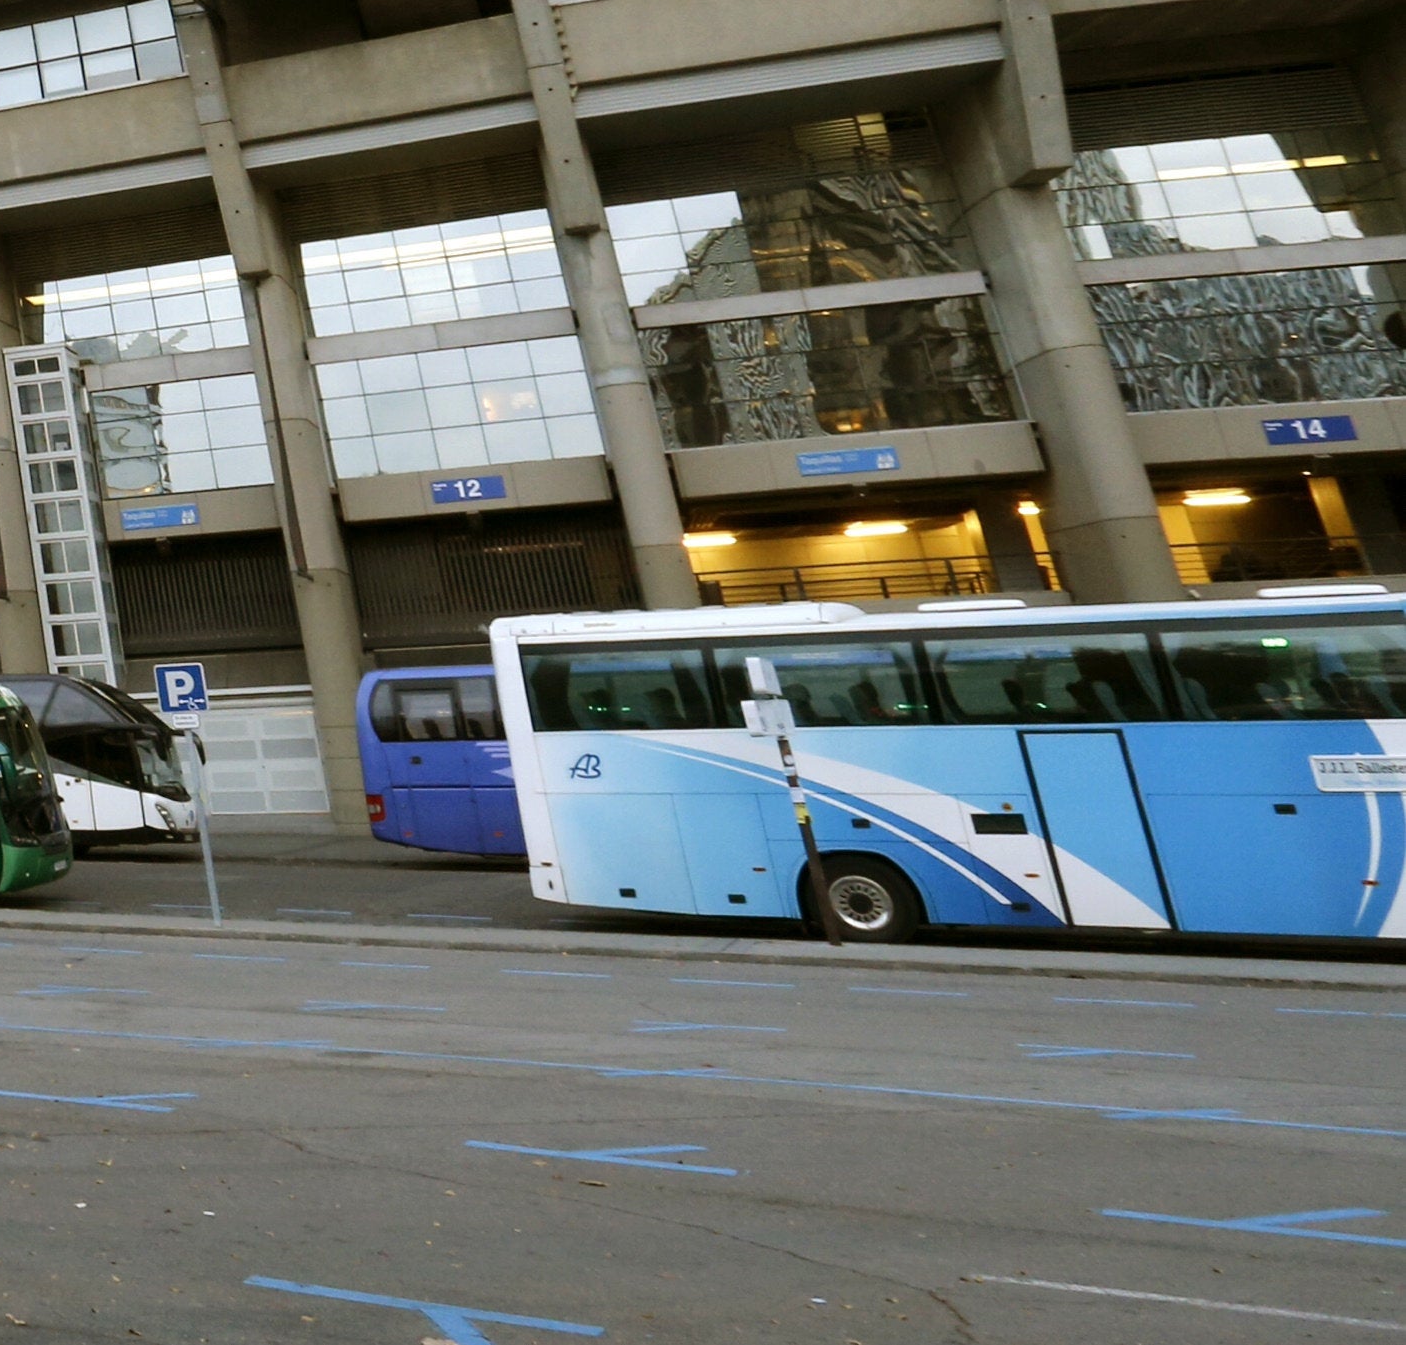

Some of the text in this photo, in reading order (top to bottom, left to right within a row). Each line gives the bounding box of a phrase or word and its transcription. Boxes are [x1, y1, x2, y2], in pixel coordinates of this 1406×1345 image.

[1291, 419, 1327, 440] 14
[454, 479, 483, 498] 12
[165, 670, 195, 708] P
